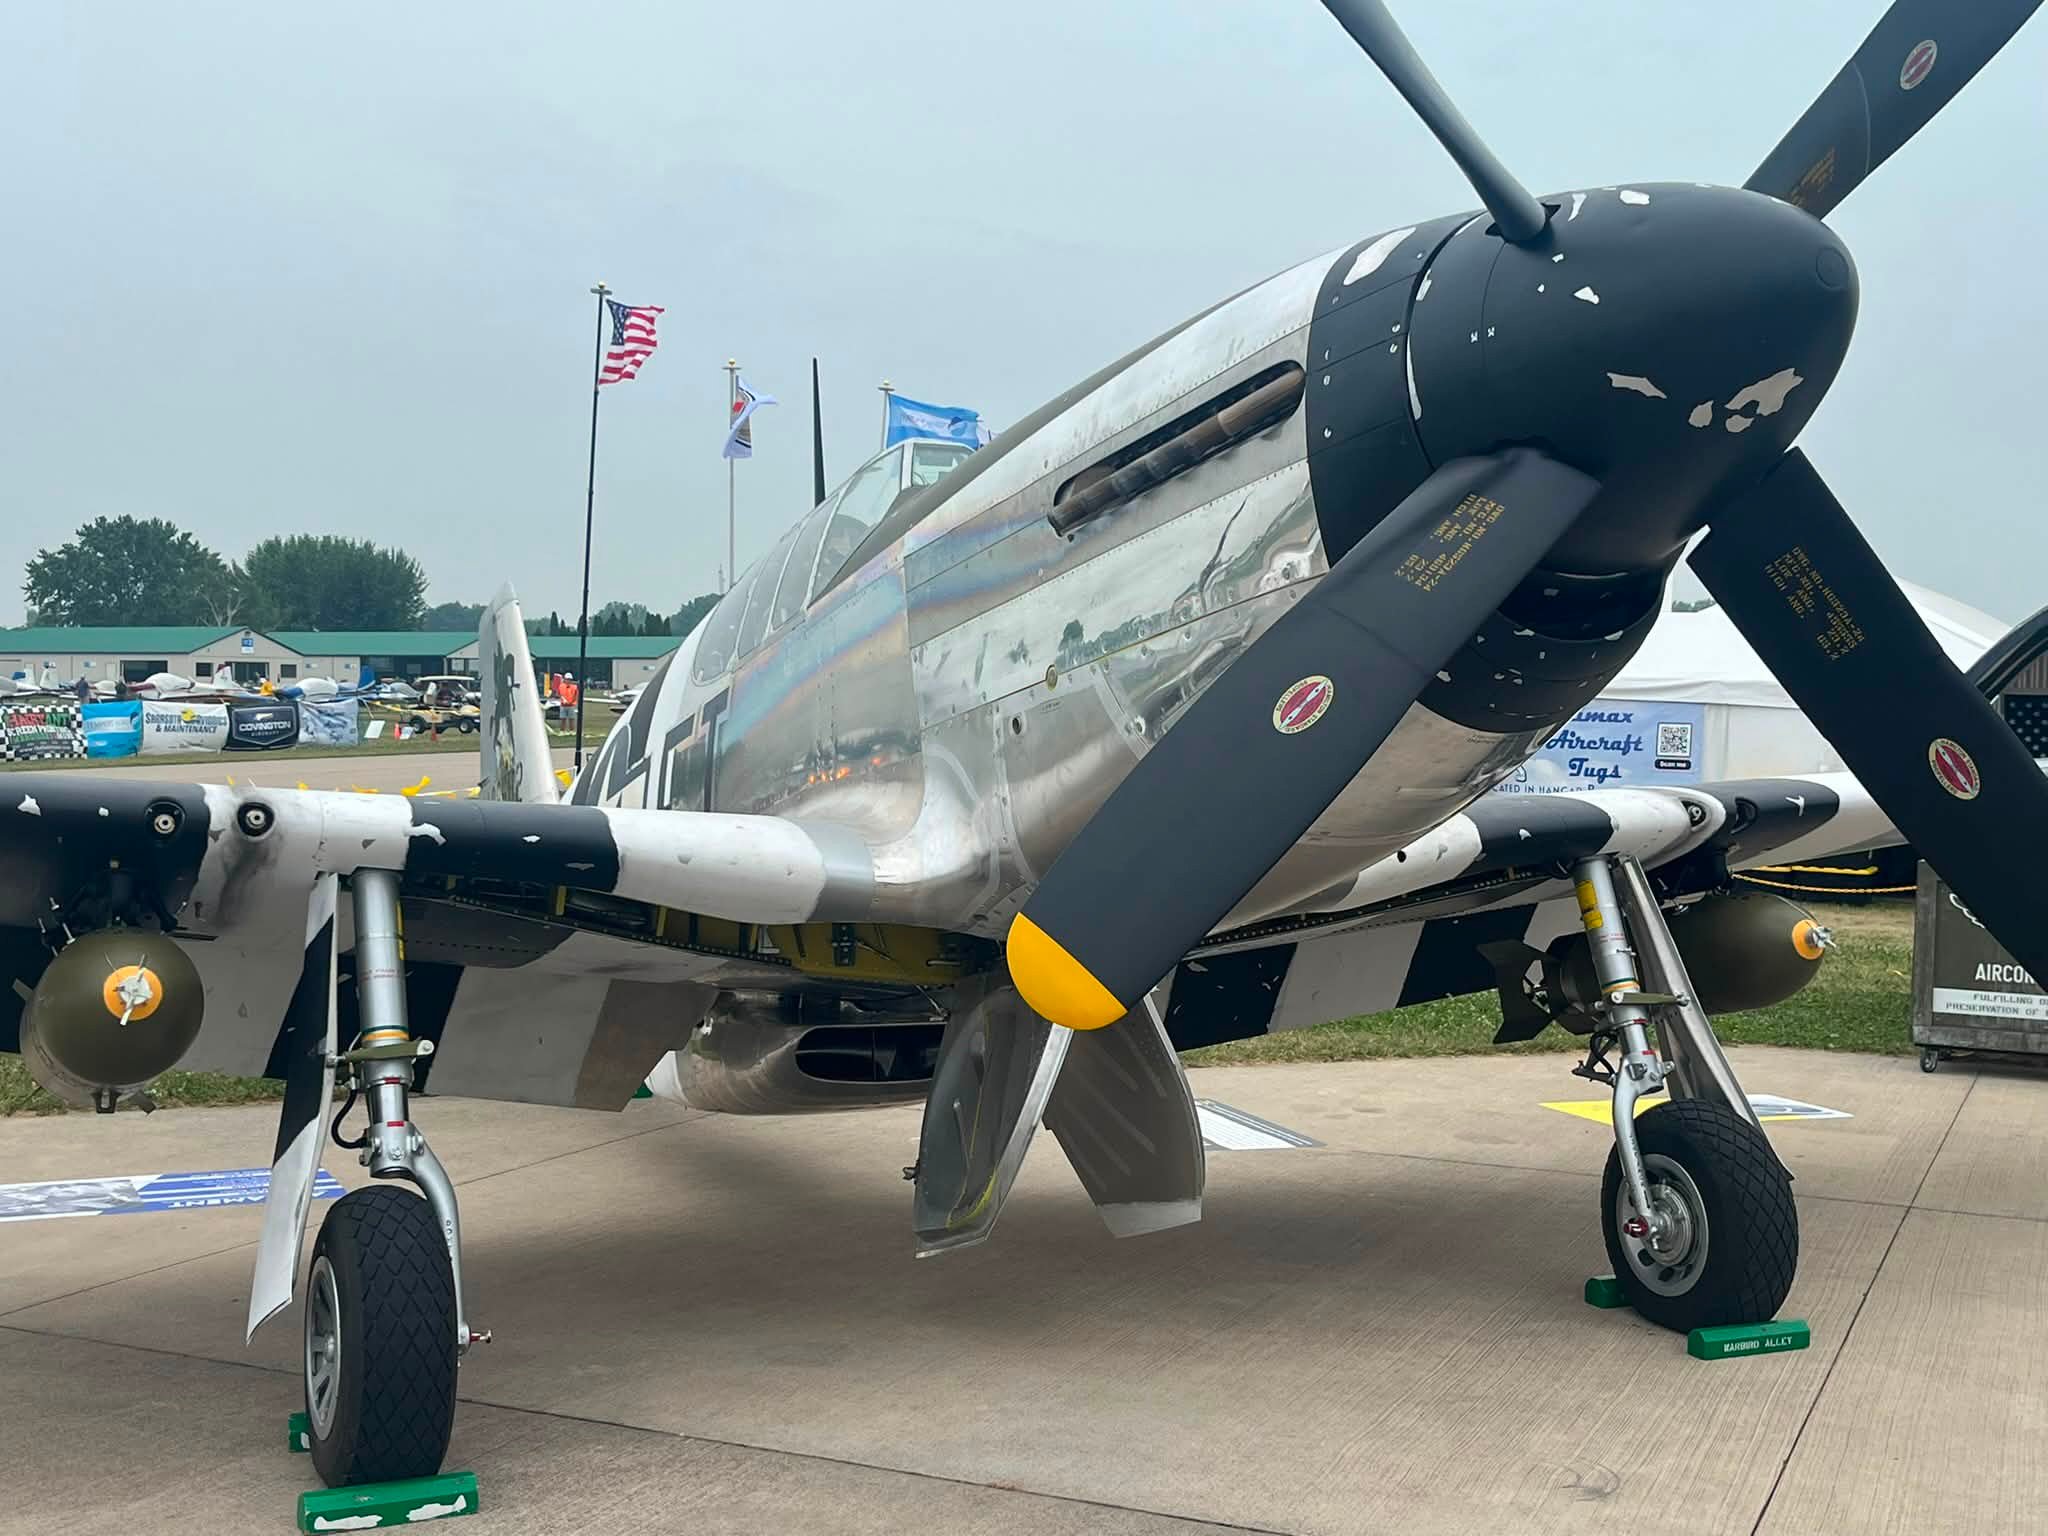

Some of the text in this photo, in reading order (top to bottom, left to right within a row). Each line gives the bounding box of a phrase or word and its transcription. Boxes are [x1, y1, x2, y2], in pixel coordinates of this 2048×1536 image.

[163, 725, 217, 734] MAINTENANCE
[239, 721, 291, 732] COVINGTON
[1546, 729, 1644, 756] Aircraft
[1568, 757, 1623, 785] Tugs
[1524, 784, 1535, 793] IN
[1973, 993, 2033, 1004] FULFILLING
[1945, 1002, 2019, 1015] PRESERVATION
[1764, 1336, 1792, 1348] ALLEY
